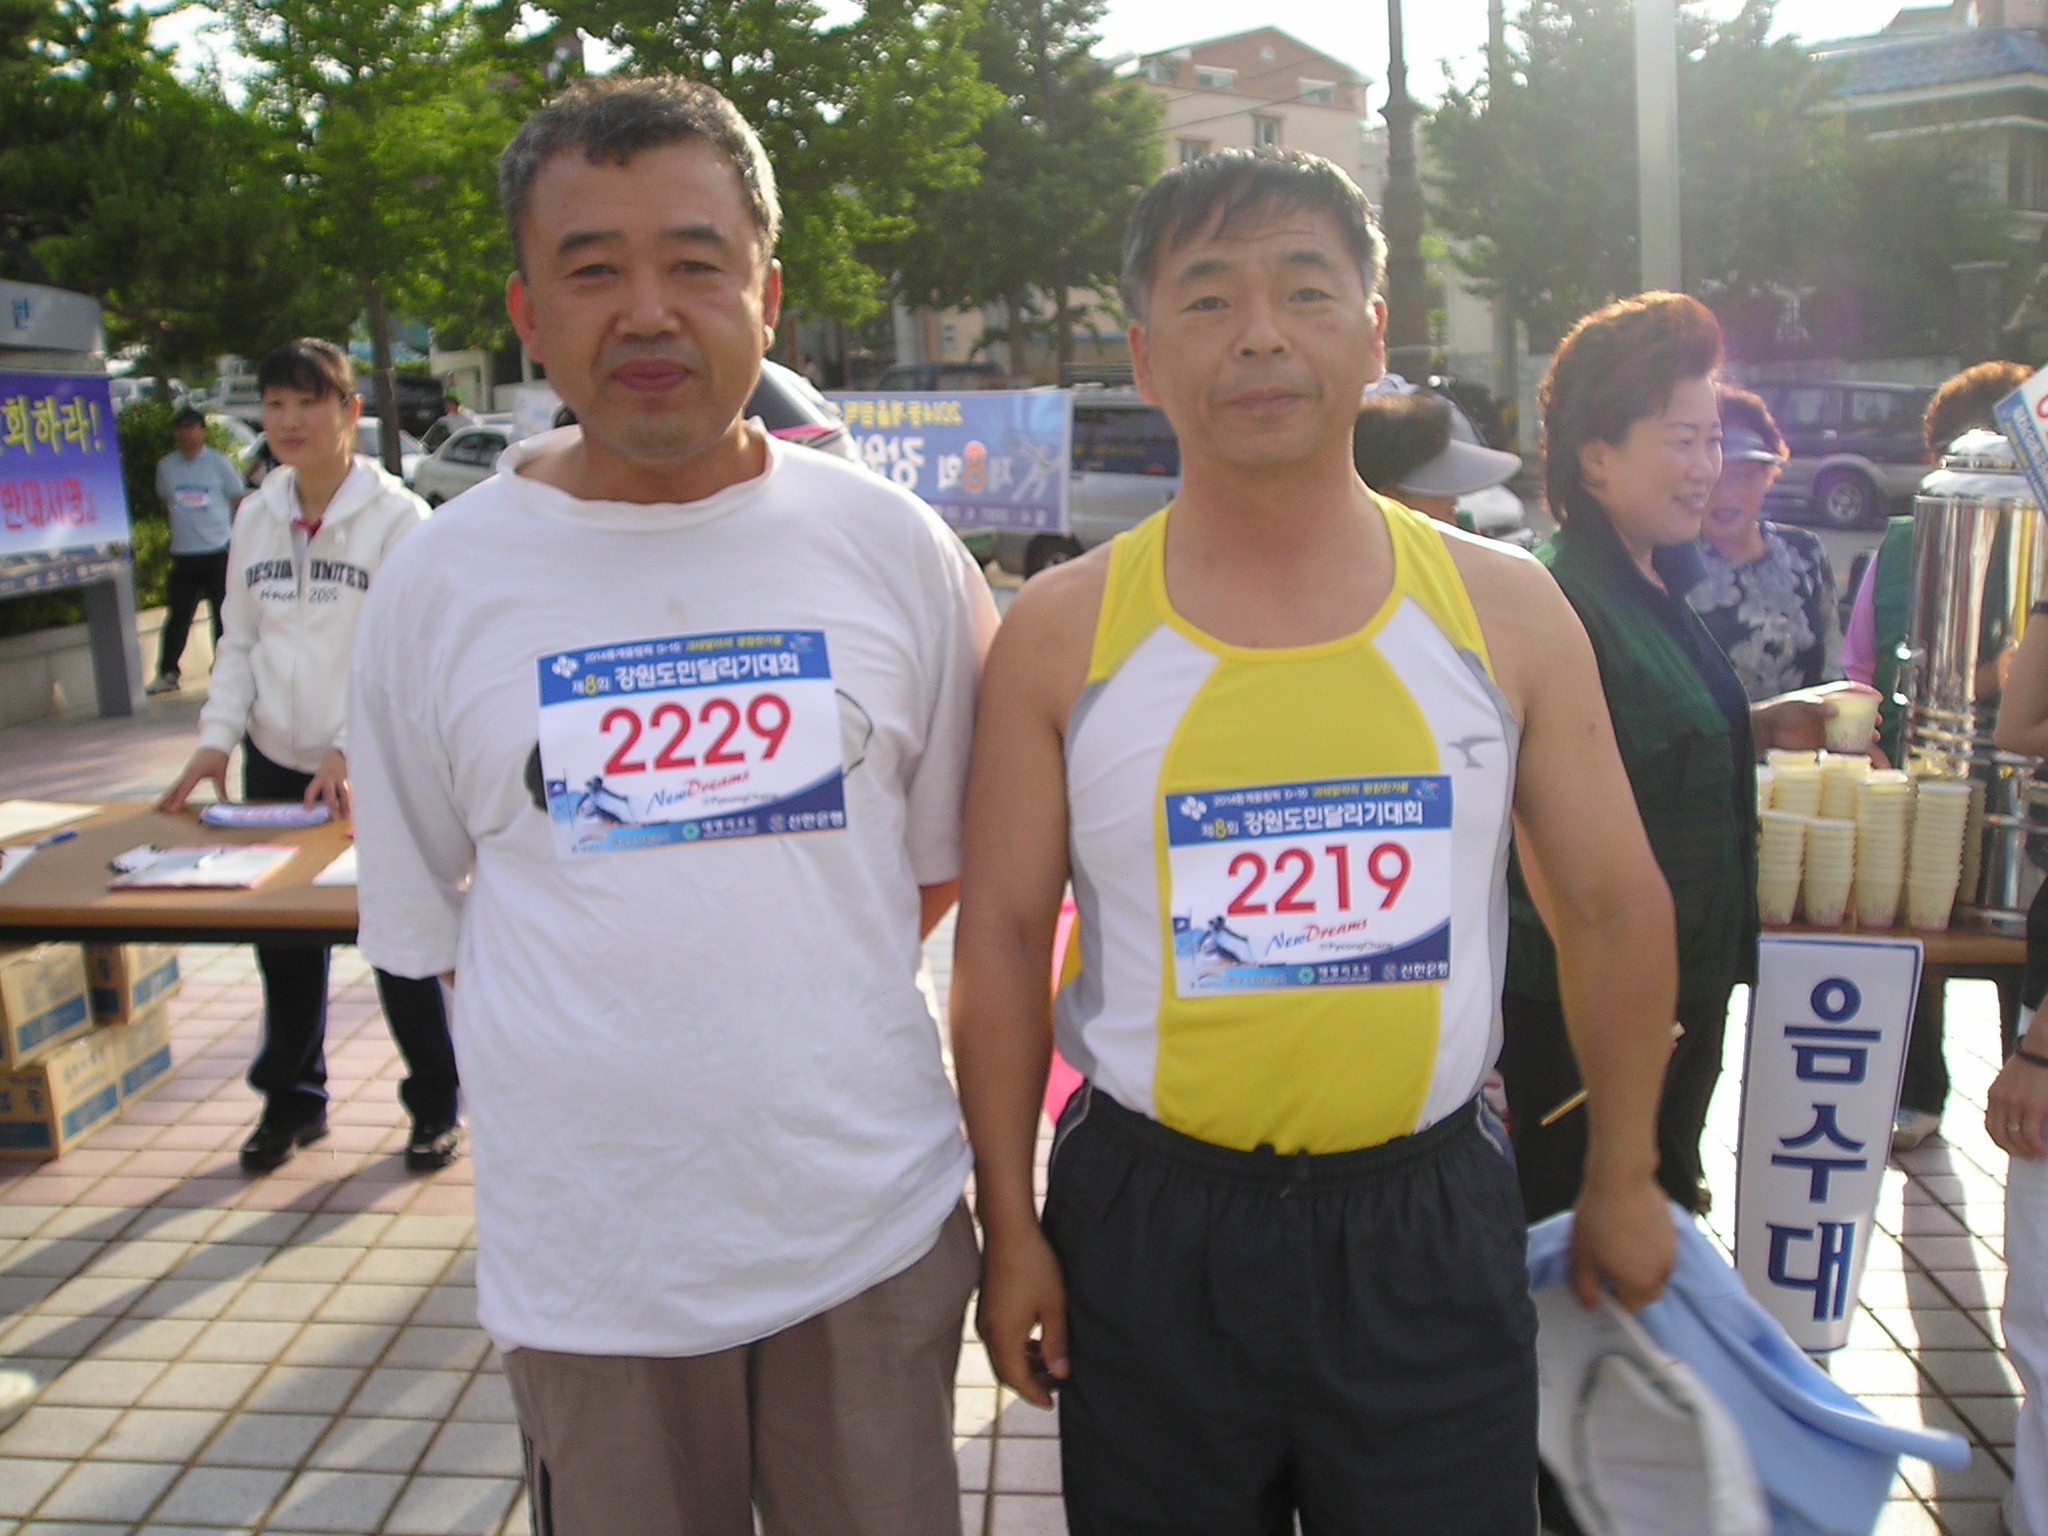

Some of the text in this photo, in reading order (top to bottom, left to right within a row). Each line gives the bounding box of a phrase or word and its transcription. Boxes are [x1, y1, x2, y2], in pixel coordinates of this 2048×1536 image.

[0, 394, 104, 456] 회하라!
[310, 558, 369, 593] UNITED
[571, 652, 800, 697] 제8회 강원도민달리기대회
[598, 692, 793, 778] 2229
[1200, 800, 1423, 841] 제8회 강원도민달리기대회
[1226, 841, 1412, 918] 2219
[1765, 975, 1883, 1322] 음수대
